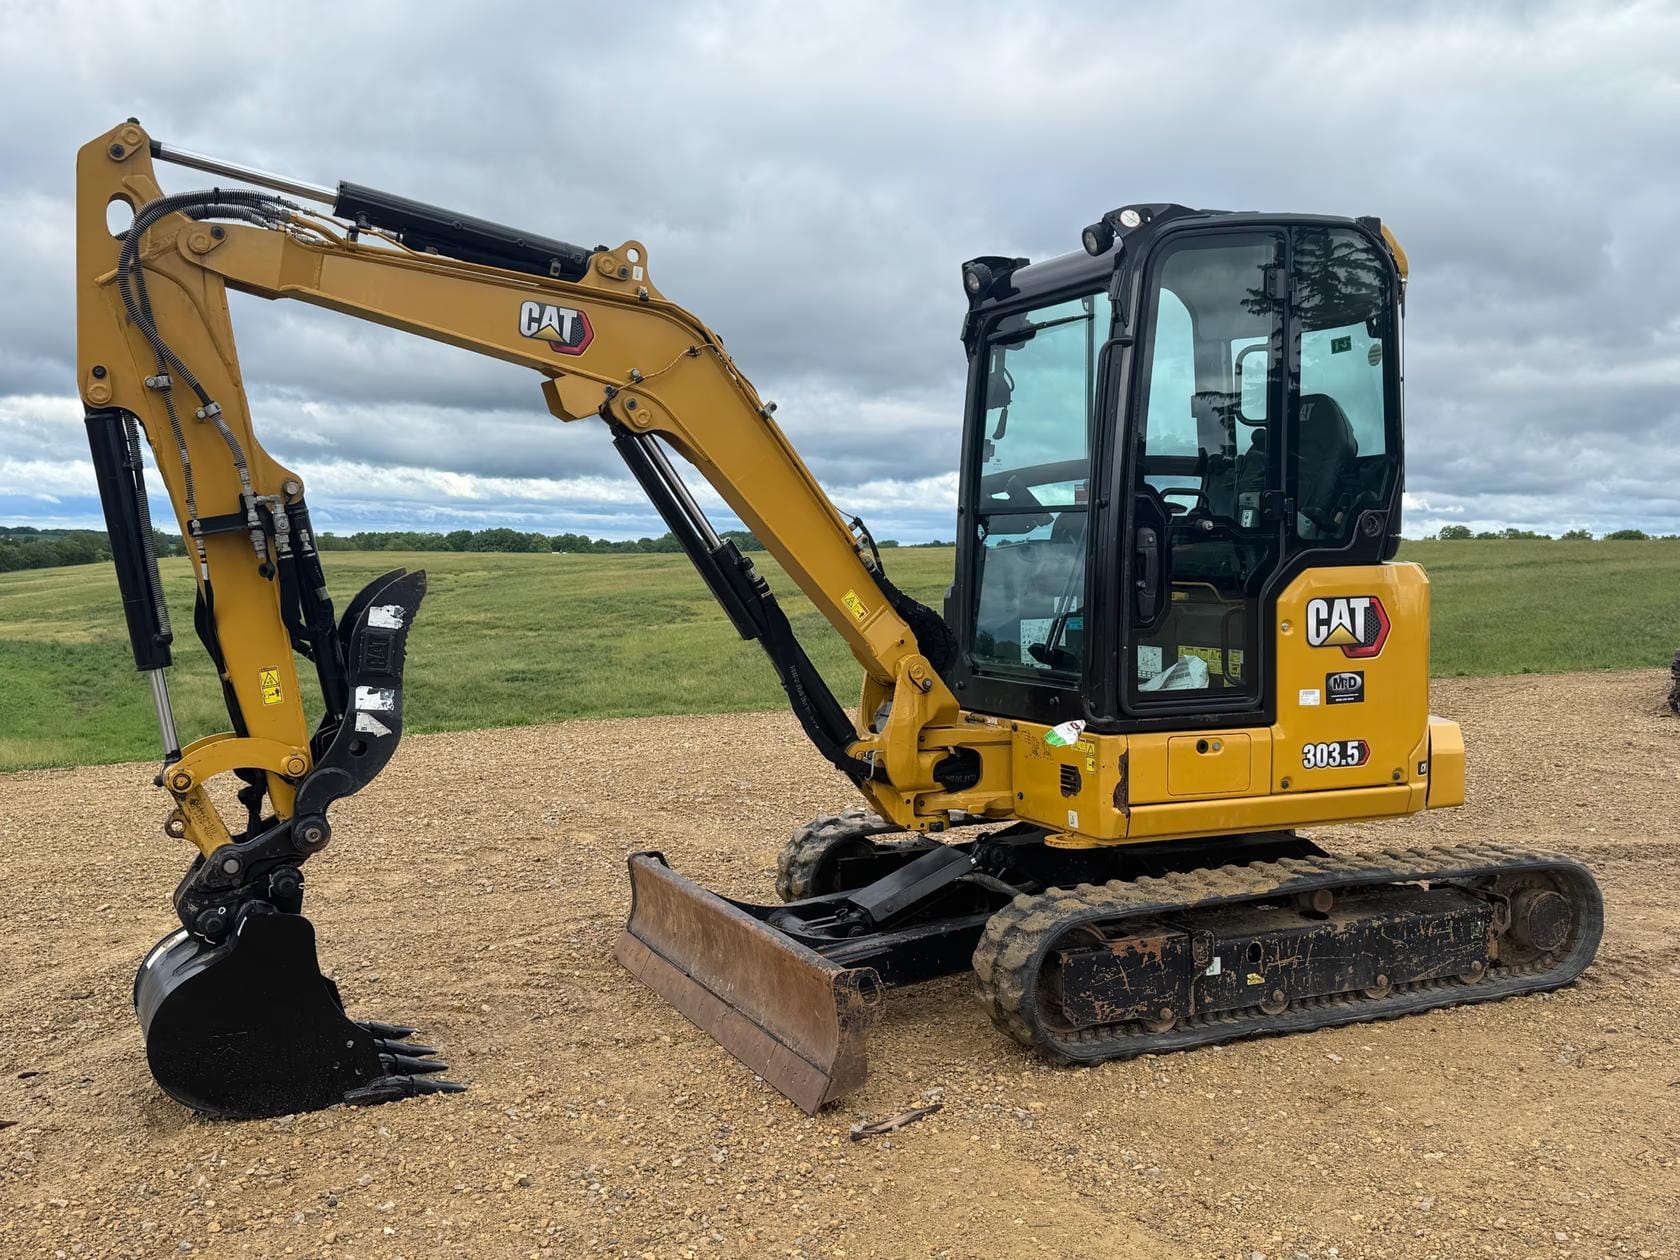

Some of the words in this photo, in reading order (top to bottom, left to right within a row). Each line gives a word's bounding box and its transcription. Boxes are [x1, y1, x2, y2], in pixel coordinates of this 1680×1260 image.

[521, 301, 578, 344] CAT
[1307, 597, 1370, 647] CAT
[1303, 741, 1360, 769] 303.5
